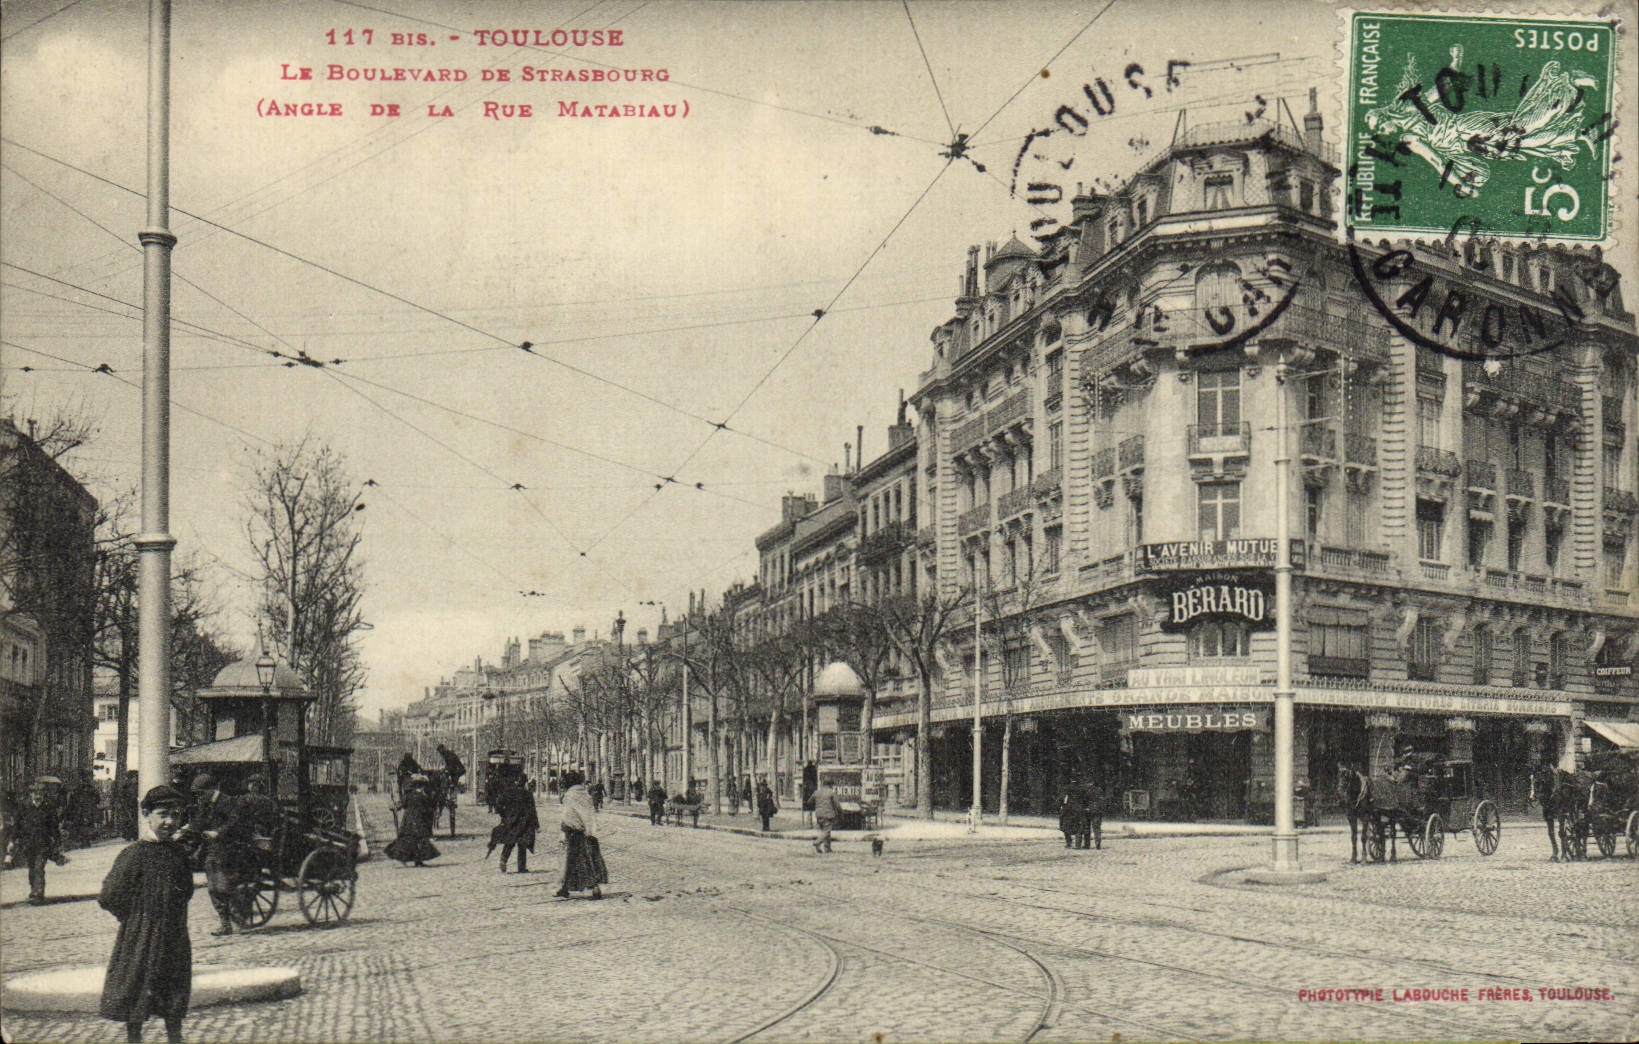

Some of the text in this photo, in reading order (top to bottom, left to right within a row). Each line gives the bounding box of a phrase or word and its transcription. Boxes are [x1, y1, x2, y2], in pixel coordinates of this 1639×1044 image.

[1515, 28, 1598, 52] POSTES
[1359, 22, 1381, 105] FRANÇAISE
[1146, 541, 1214, 559] L'AVENIR
[1226, 539, 1279, 555] MUTUE
[1195, 572, 1238, 585] MAISON
[1172, 585, 1265, 624] BÉRARD
[1128, 712, 1258, 729] MEUBLES
